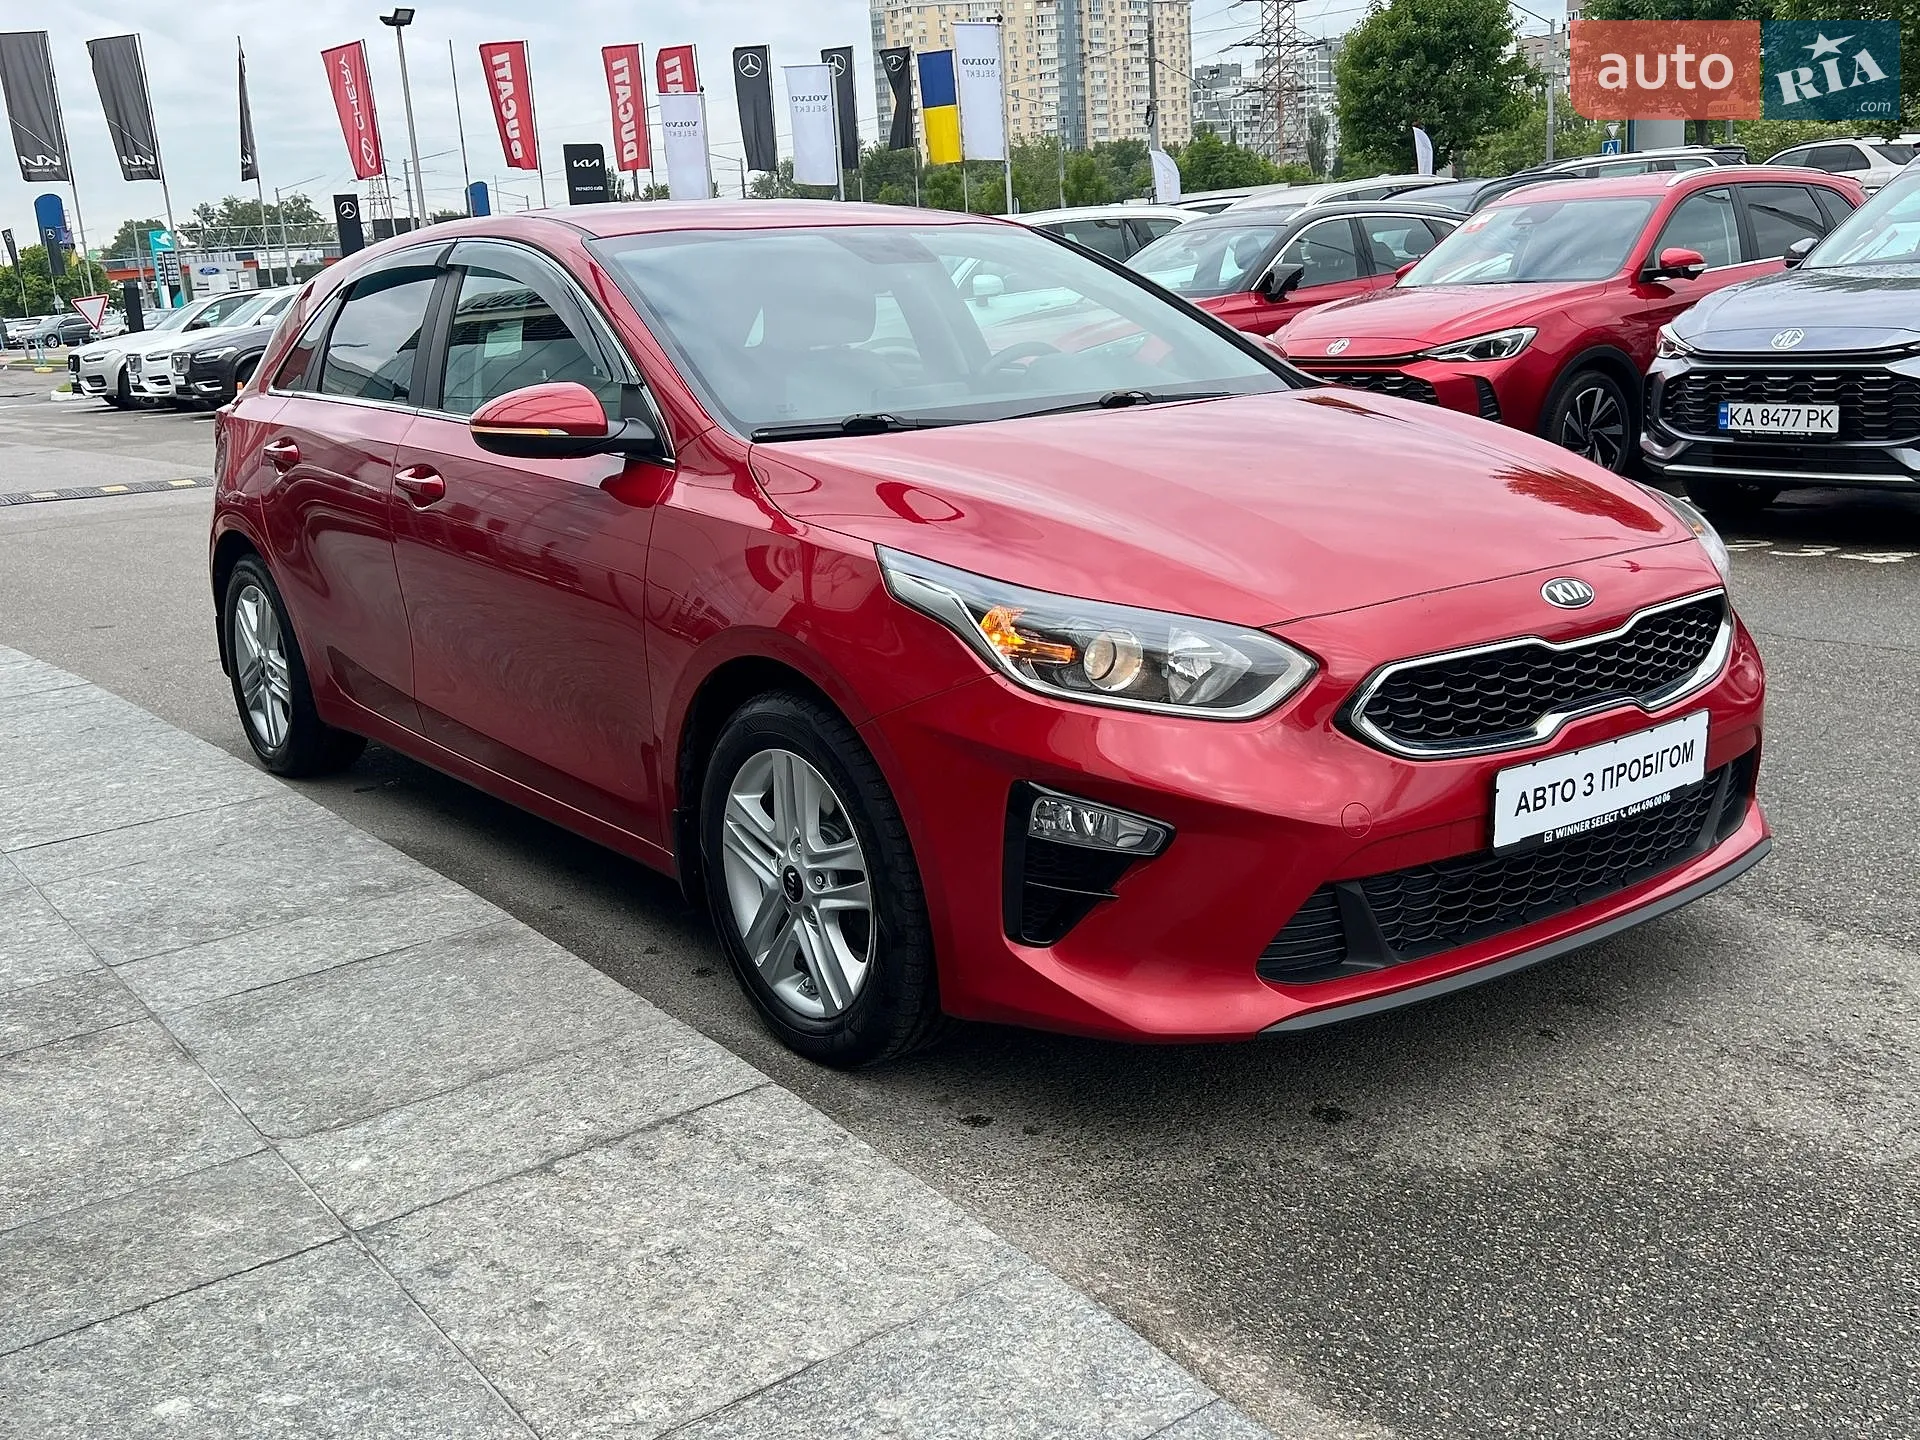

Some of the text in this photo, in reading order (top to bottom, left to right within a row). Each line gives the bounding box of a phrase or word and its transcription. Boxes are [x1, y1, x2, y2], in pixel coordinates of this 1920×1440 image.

[573, 158, 600, 168] KIA
[1729, 407, 1834, 429] KA 8477 PK
[1547, 580, 1592, 604] KIA
[1514, 777, 1576, 817] АВТО
[1601, 739, 1695, 792] ПРОБІГОМ
[1555, 819, 1590, 840] WINNER
[1591, 811, 1619, 829] SELECT
